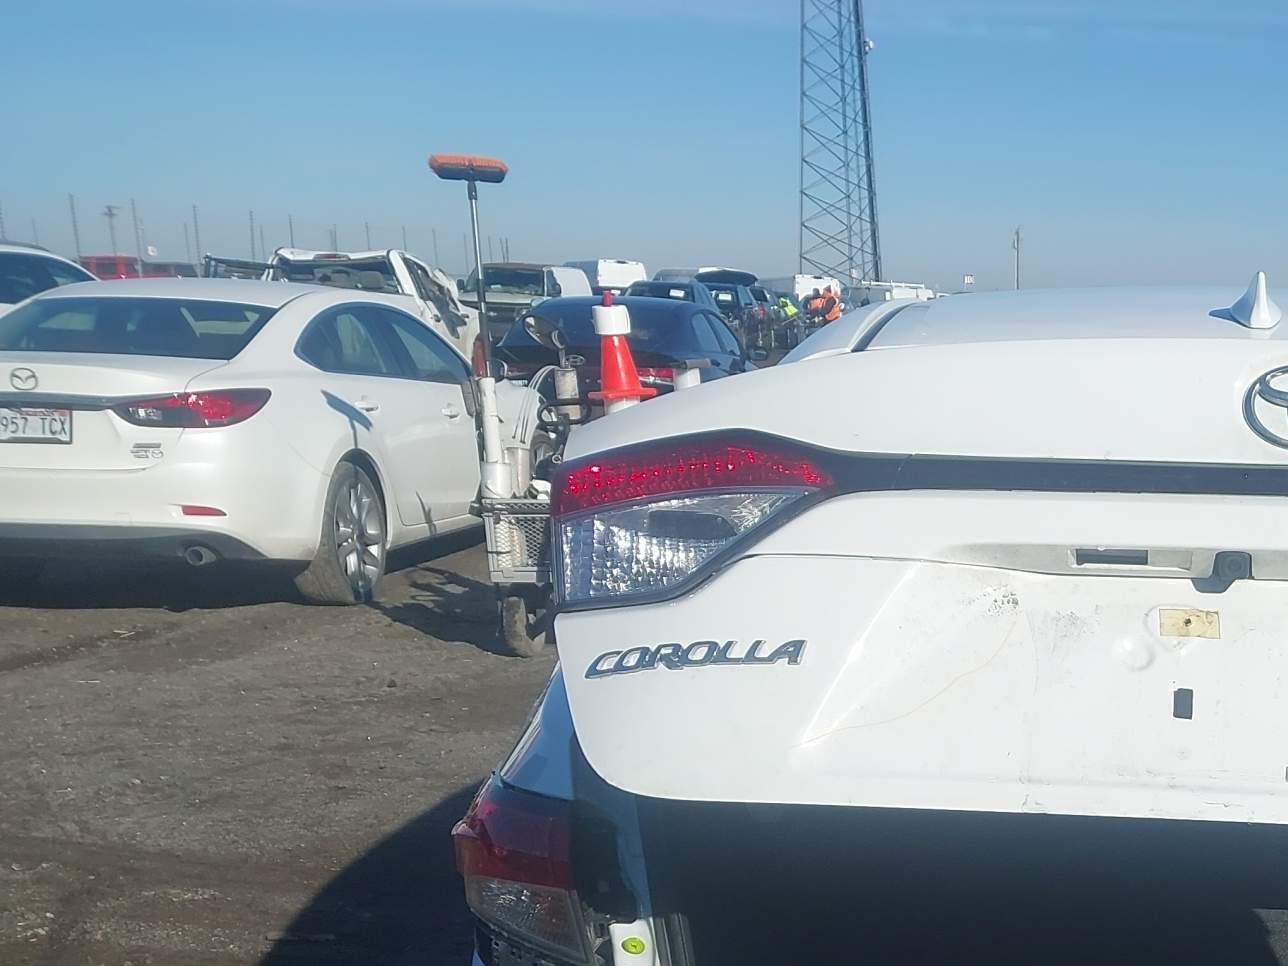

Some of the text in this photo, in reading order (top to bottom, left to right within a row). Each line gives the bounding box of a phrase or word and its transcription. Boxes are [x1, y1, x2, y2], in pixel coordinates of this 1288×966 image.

[0, 416, 67, 435] 957 TCX
[584, 639, 808, 680] COROLLA
